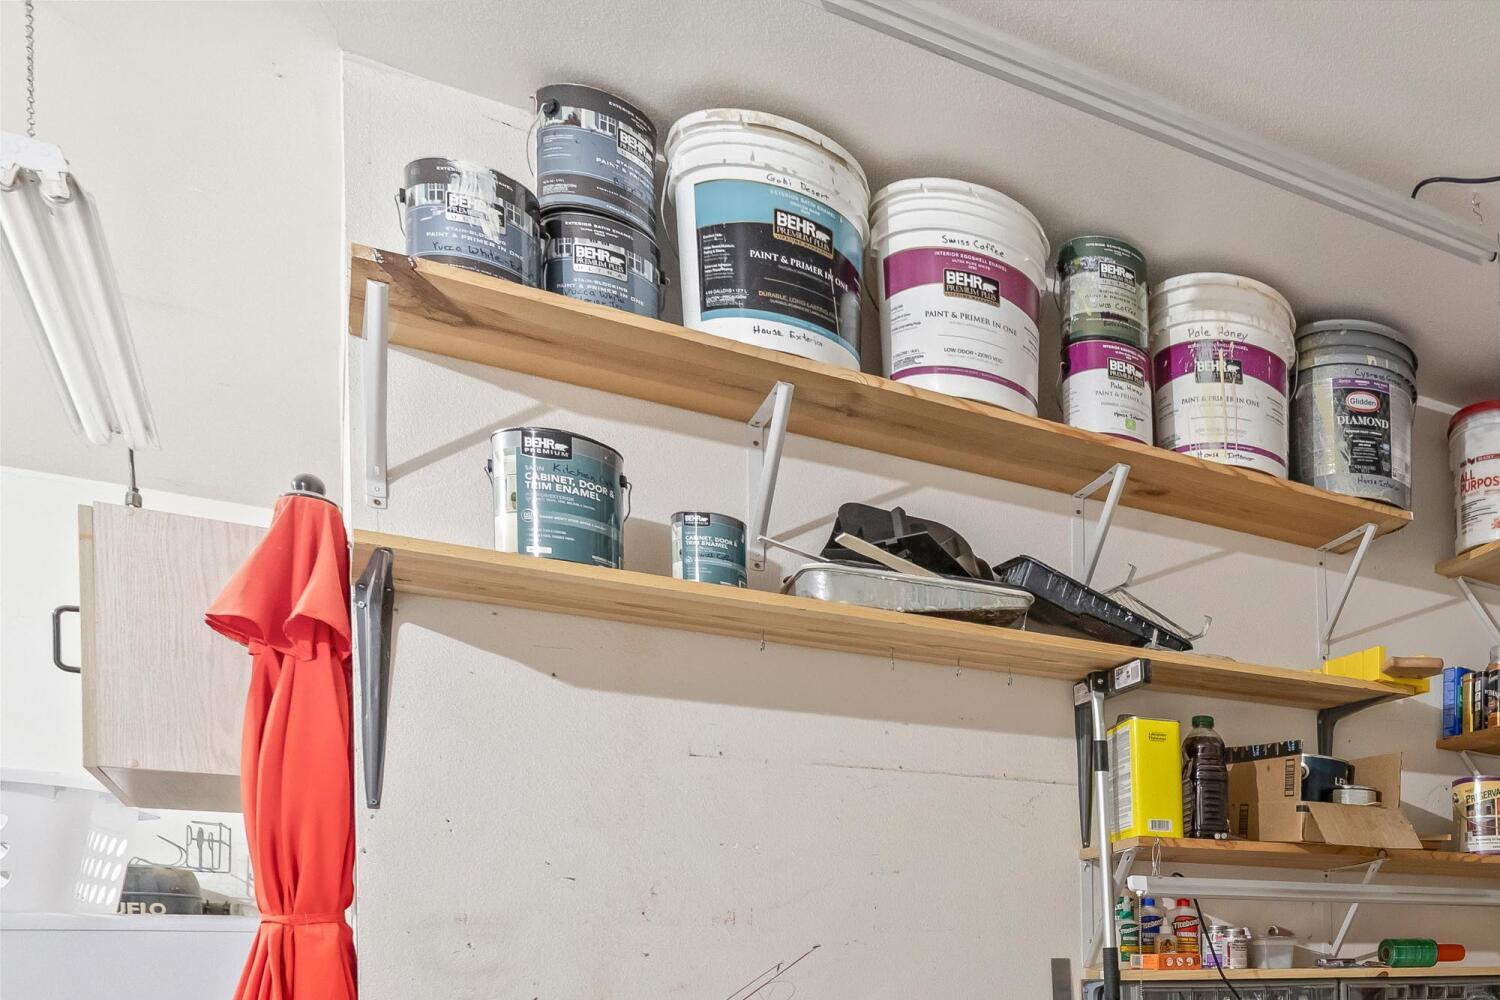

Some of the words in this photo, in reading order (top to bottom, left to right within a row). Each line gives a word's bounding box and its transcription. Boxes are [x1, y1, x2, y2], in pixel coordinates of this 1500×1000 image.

[619, 130, 646, 158] BEHR
[800, 182, 830, 201] Desert
[776, 211, 816, 237] BEHR
[776, 226, 812, 245] PREMIUM
[813, 236, 830, 252] PLUS
[942, 234, 969, 246] Swiss
[974, 240, 1005, 258] Coffee
[575, 245, 610, 262] BEHR
[575, 257, 607, 268] PREMIUM
[608, 262, 624, 273] PLUS
[750, 249, 779, 262] PAINT
[780, 255, 789, 264] &
[790, 259, 823, 278] PRIMER
[824, 271, 834, 282] IN
[1101, 263, 1125, 276] BEHR
[945, 271, 982, 288] BEHR
[946, 285, 979, 297] PREMIUM
[981, 291, 997, 301] PLUS
[925, 310, 949, 318] PAINT
[951, 311, 958, 319] &
[960, 312, 990, 325] PRIMER
[992, 321, 1001, 329] IN
[1003, 325, 1017, 336] ONE
[753, 325, 784, 338] House
[1188, 326, 1211, 338] Pale
[957, 348, 974, 356] ODOR
[1109, 359, 1135, 376] BEHR
[1196, 361, 1227, 372] BEHR
[1181, 396, 1199, 405] PAINT
[1246, 399, 1260, 408] ONE
[1349, 397, 1376, 406] Glidden
[1337, 415, 1389, 429] DIAMOND
[524, 436, 555, 450] BEHR
[524, 447, 569, 458] PREMIUM
[1461, 469, 1475, 481] ALL
[524, 480, 552, 490] TRIM
[556, 484, 601, 502] ENAMEL
[525, 472, 576, 487] CABINET,
[579, 480, 608, 496] DOOR
[609, 490, 615, 499] &
[701, 541, 728, 550] ENAMEL
